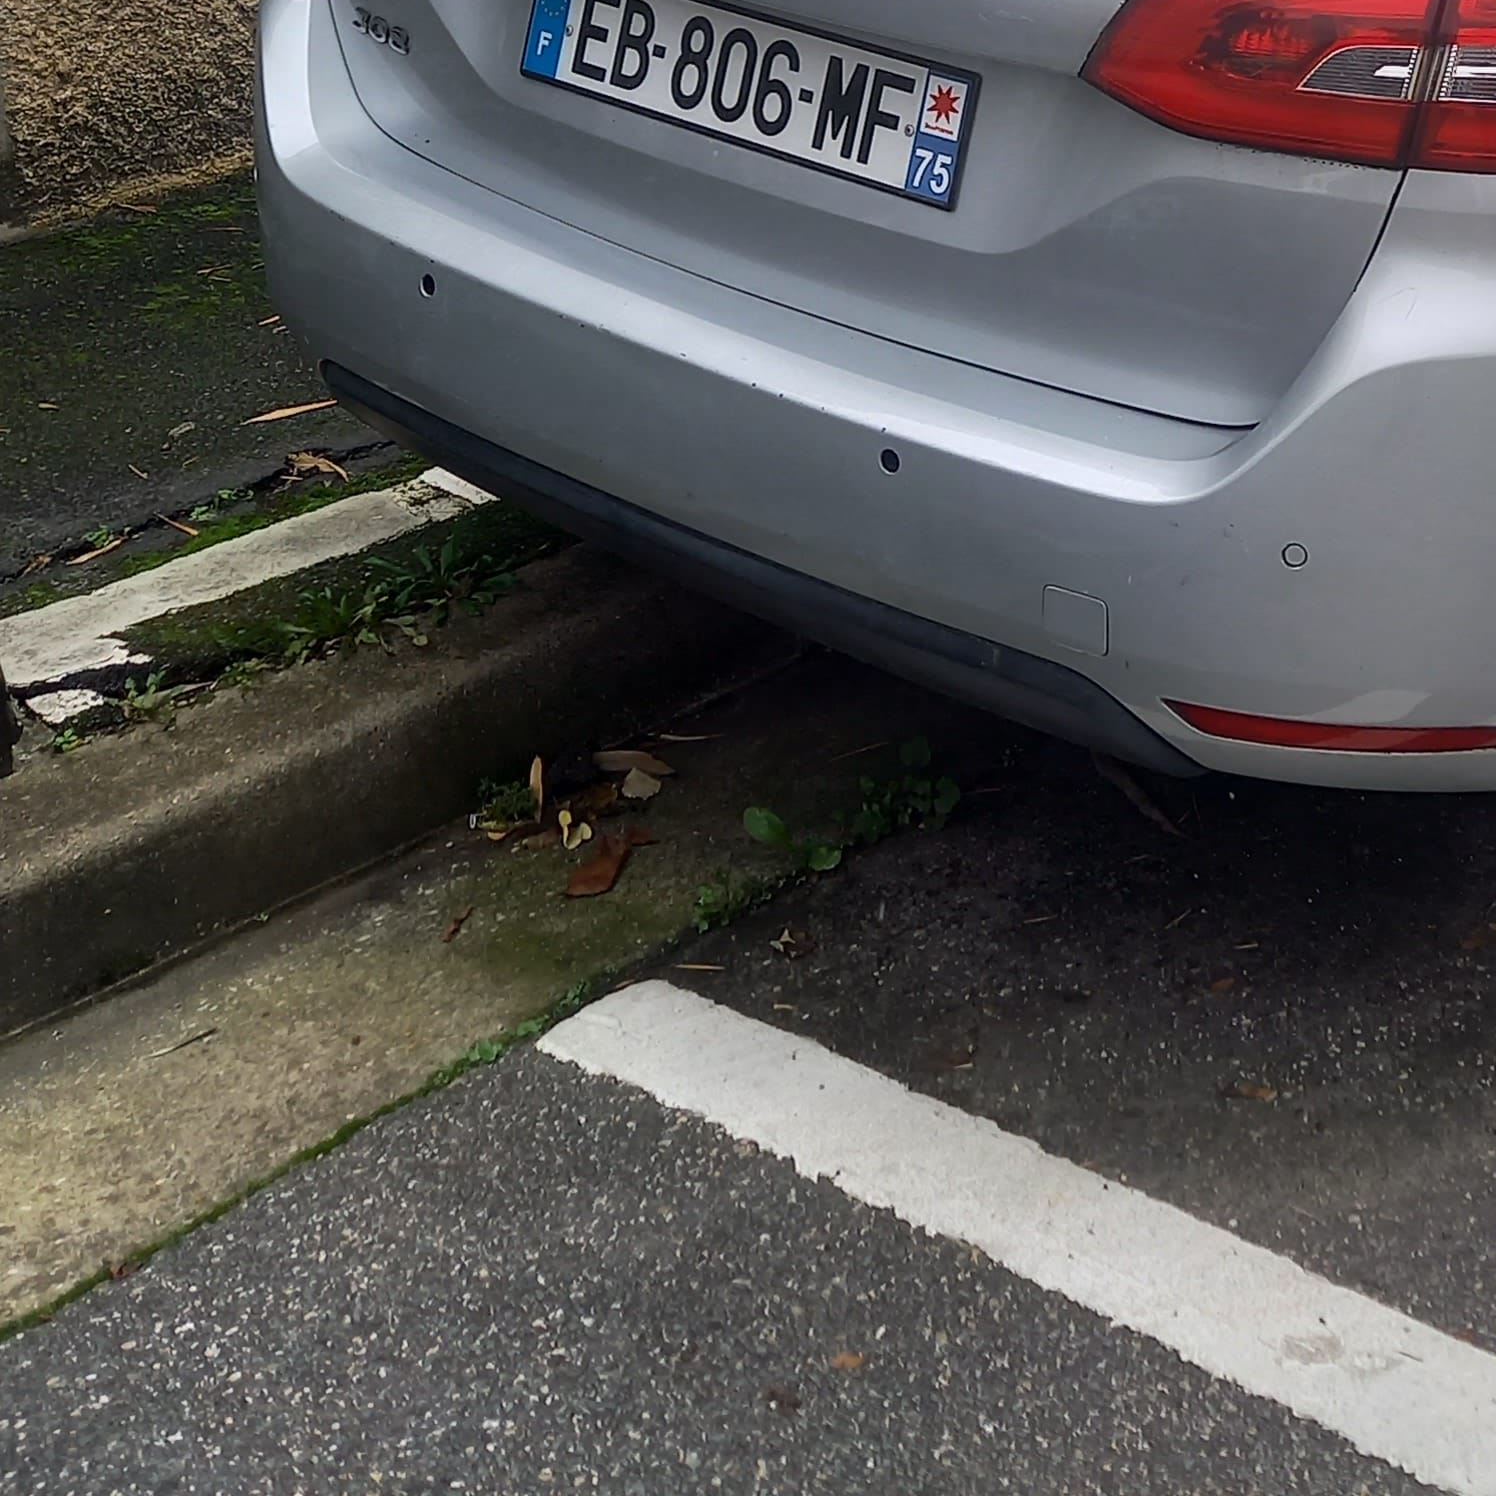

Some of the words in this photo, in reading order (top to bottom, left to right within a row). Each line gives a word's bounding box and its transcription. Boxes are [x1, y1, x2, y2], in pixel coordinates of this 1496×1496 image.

[352, 6, 410, 56] 308
[536, 32, 552, 56] F
[912, 147, 953, 195] 75
